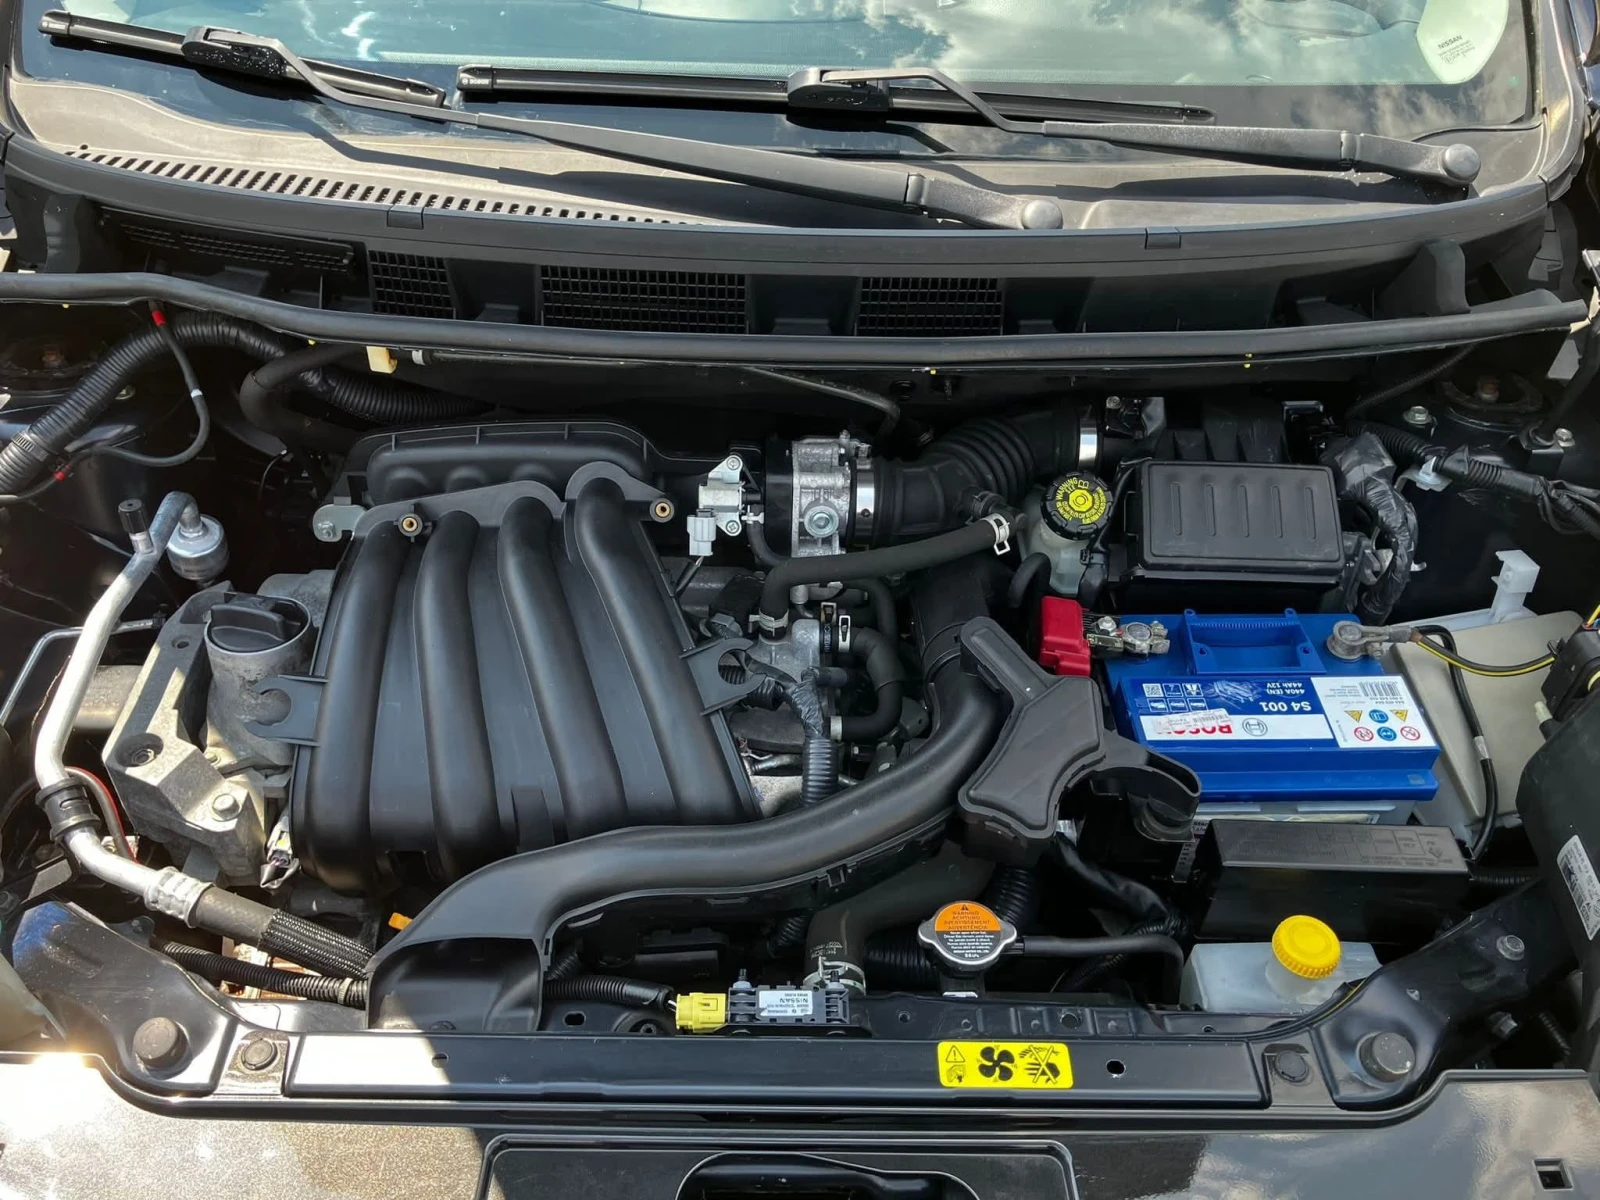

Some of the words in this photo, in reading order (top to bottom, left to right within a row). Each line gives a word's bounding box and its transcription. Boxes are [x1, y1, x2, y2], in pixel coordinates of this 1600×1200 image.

[1437, 35, 1462, 48] NISSAN
[1056, 477, 1078, 500] WARNING
[1259, 701, 1288, 712] 001
[1291, 701, 1312, 712] S4
[1157, 724, 1233, 734] BOS
